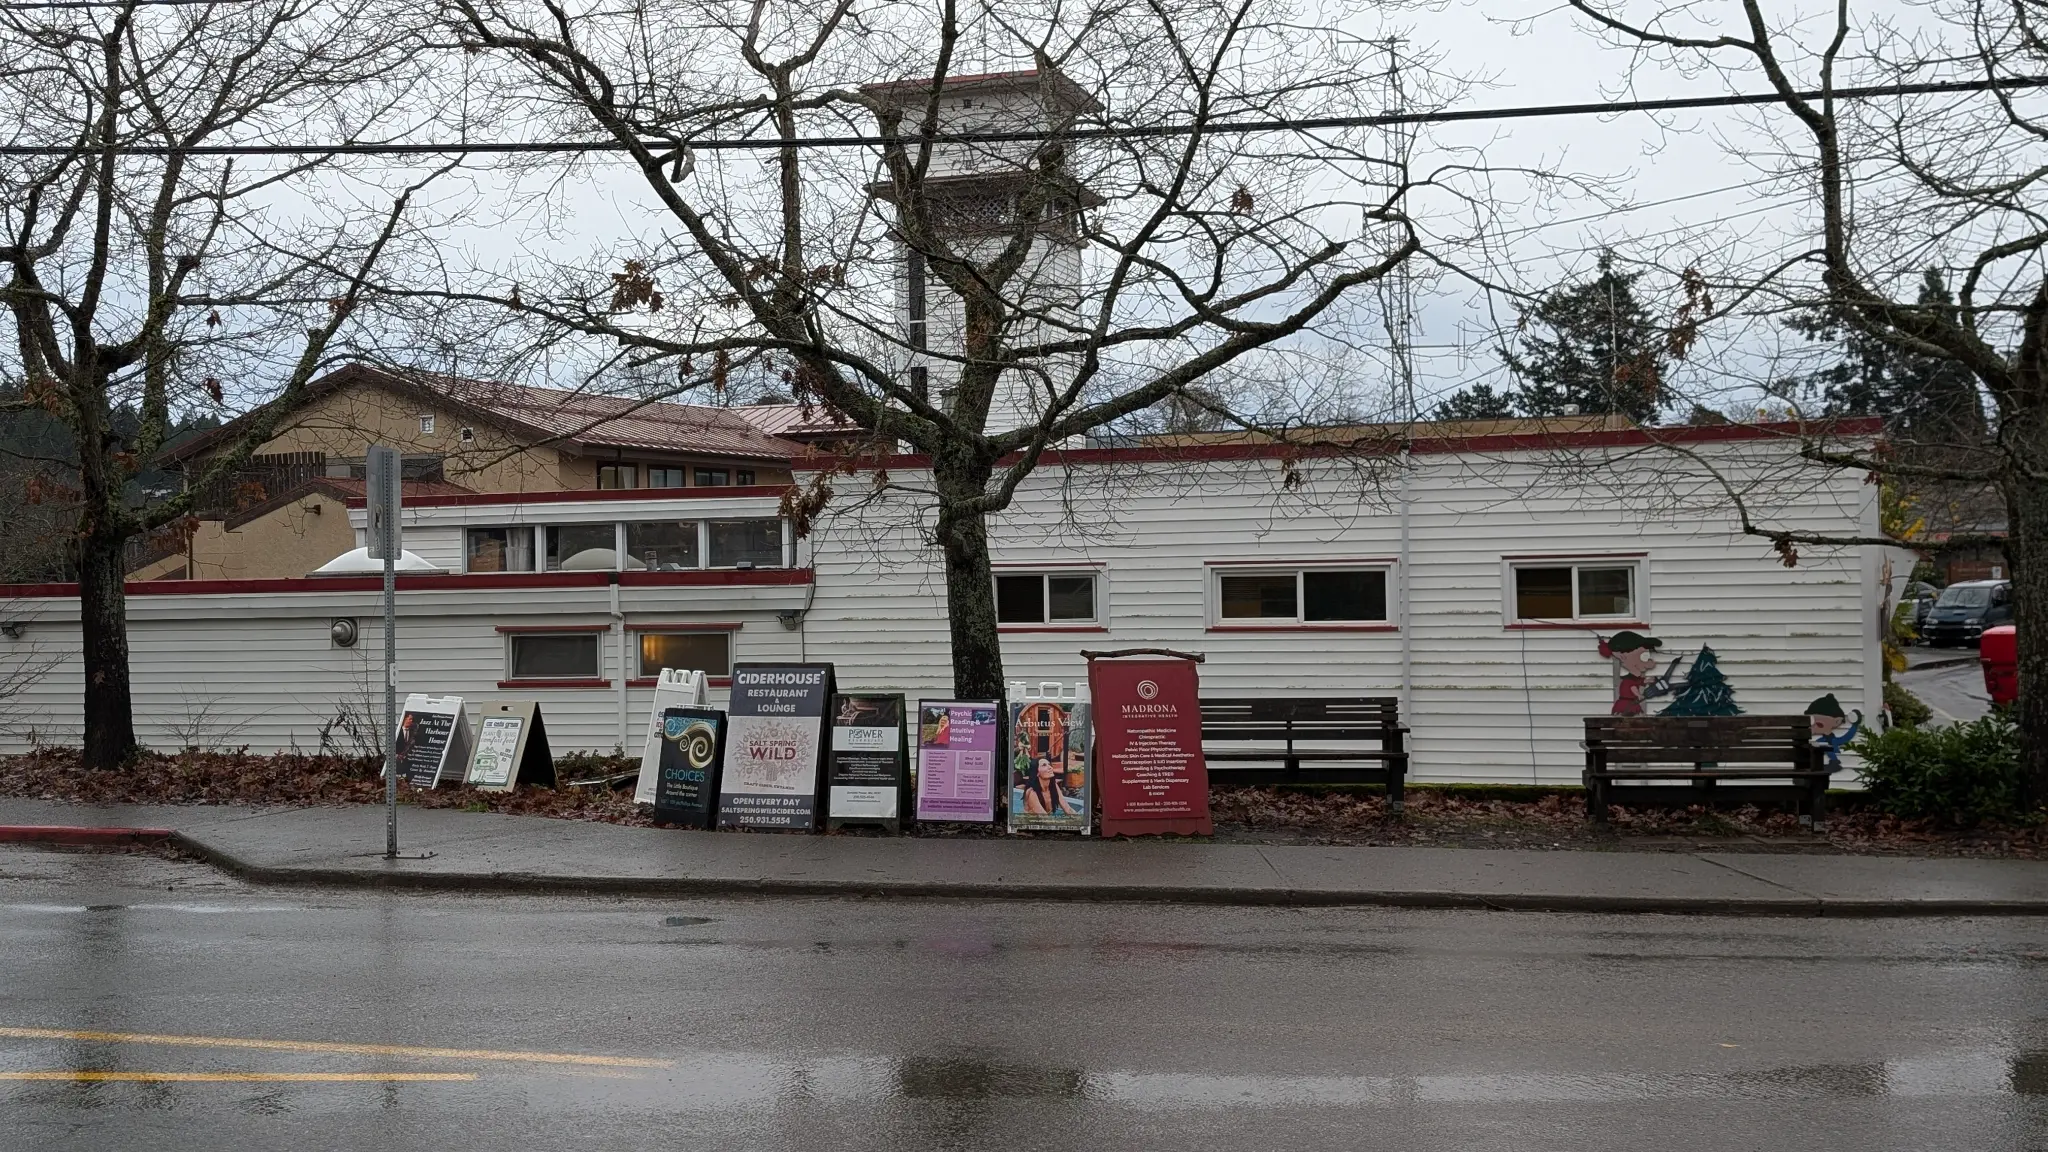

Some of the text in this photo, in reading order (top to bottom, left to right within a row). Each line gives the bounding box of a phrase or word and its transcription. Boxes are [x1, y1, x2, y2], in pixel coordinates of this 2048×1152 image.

[738, 673, 821, 685] CIDERHOUSE
[747, 689, 809, 698] RESTAURANT
[758, 704, 796, 713] LOUNGE
[1122, 704, 1177, 713] MADRONA
[950, 719, 975, 727] Reading
[1014, 717, 1084, 728] Arbutus View
[849, 729, 884, 739] POWER
[428, 737, 446, 745] House
[502, 736, 516, 746] food
[950, 736, 973, 744] Healing
[665, 768, 705, 783] CHOICES
[682, 784, 699, 792] Boutique
[733, 797, 800, 806] OPEN EVERY DAY
[721, 807, 811, 815] SALTSPRINGWILDCIDER.COM
